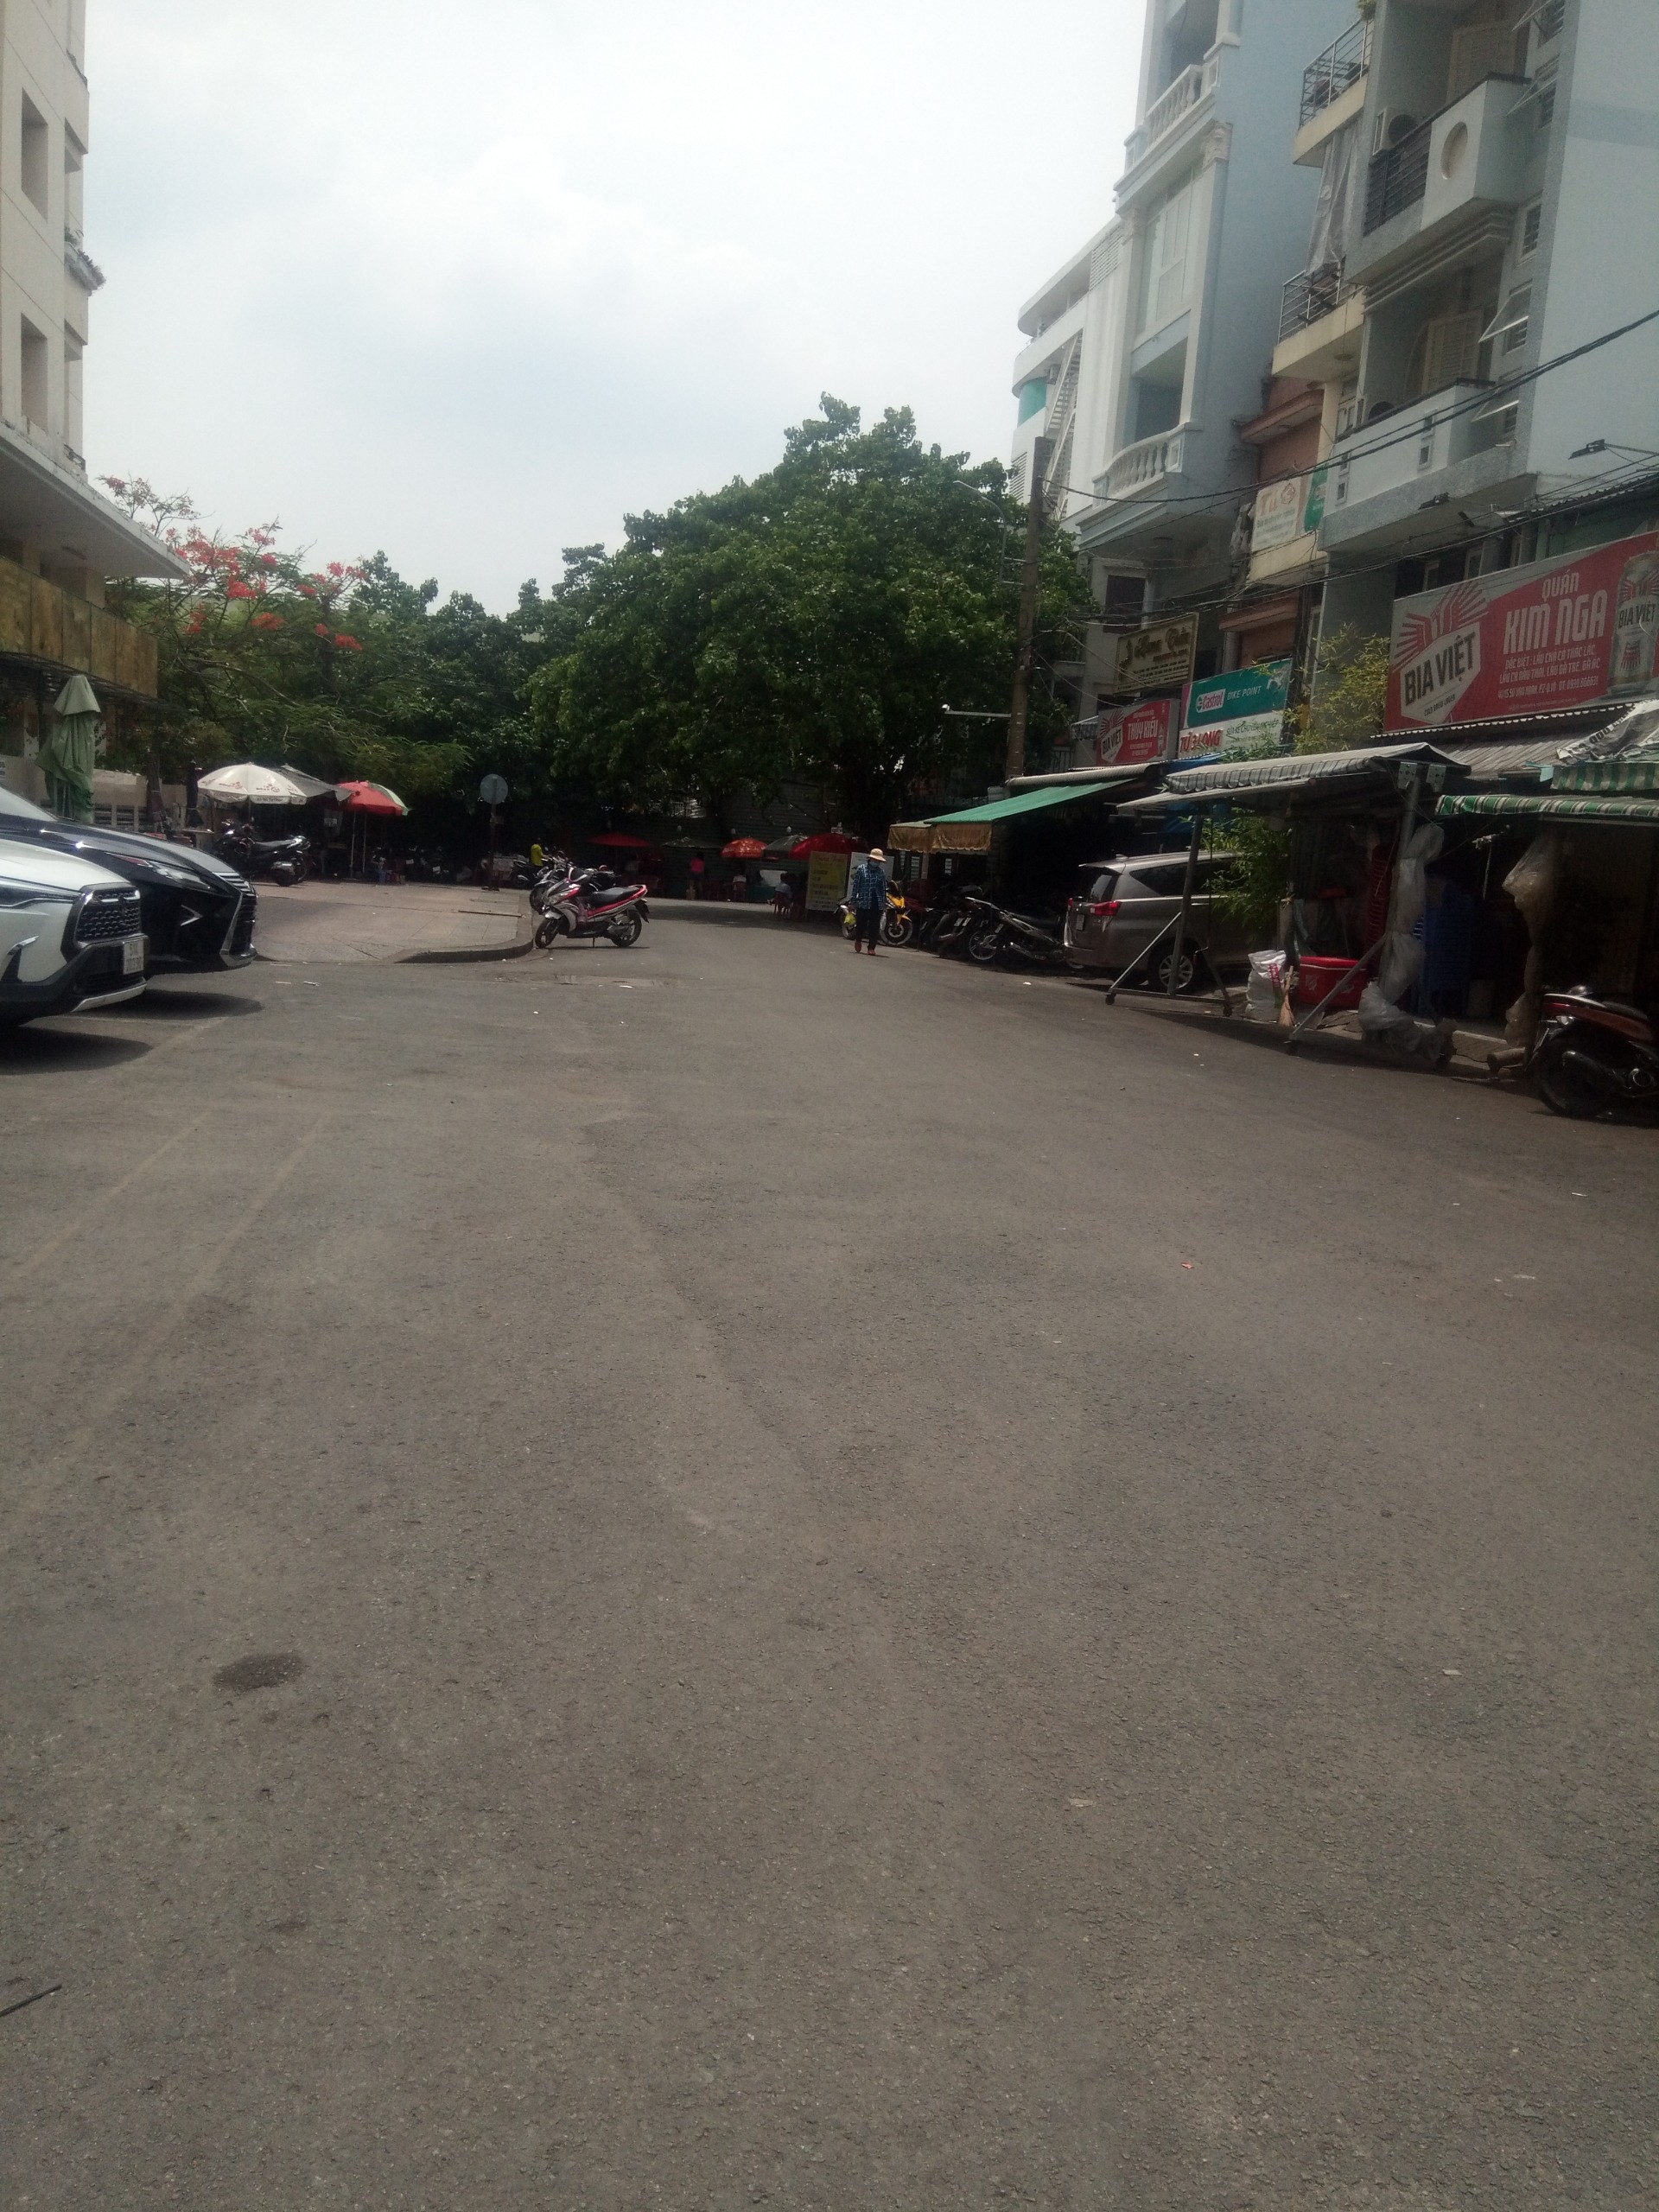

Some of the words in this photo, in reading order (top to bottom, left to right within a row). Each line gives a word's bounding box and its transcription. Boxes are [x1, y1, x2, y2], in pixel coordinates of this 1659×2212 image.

[1541, 569, 1580, 601] QUÁN
[1503, 603, 1551, 654] KIM
[1555, 589, 1608, 645] NGA
[1618, 607, 1633, 628] BIA
[1404, 659, 1434, 706] BIA
[1435, 632, 1476, 686] VIỆT
[1202, 691, 1224, 709] Castrol
[1227, 690, 1242, 701] BIKE
[1242, 685, 1262, 696] POINT
